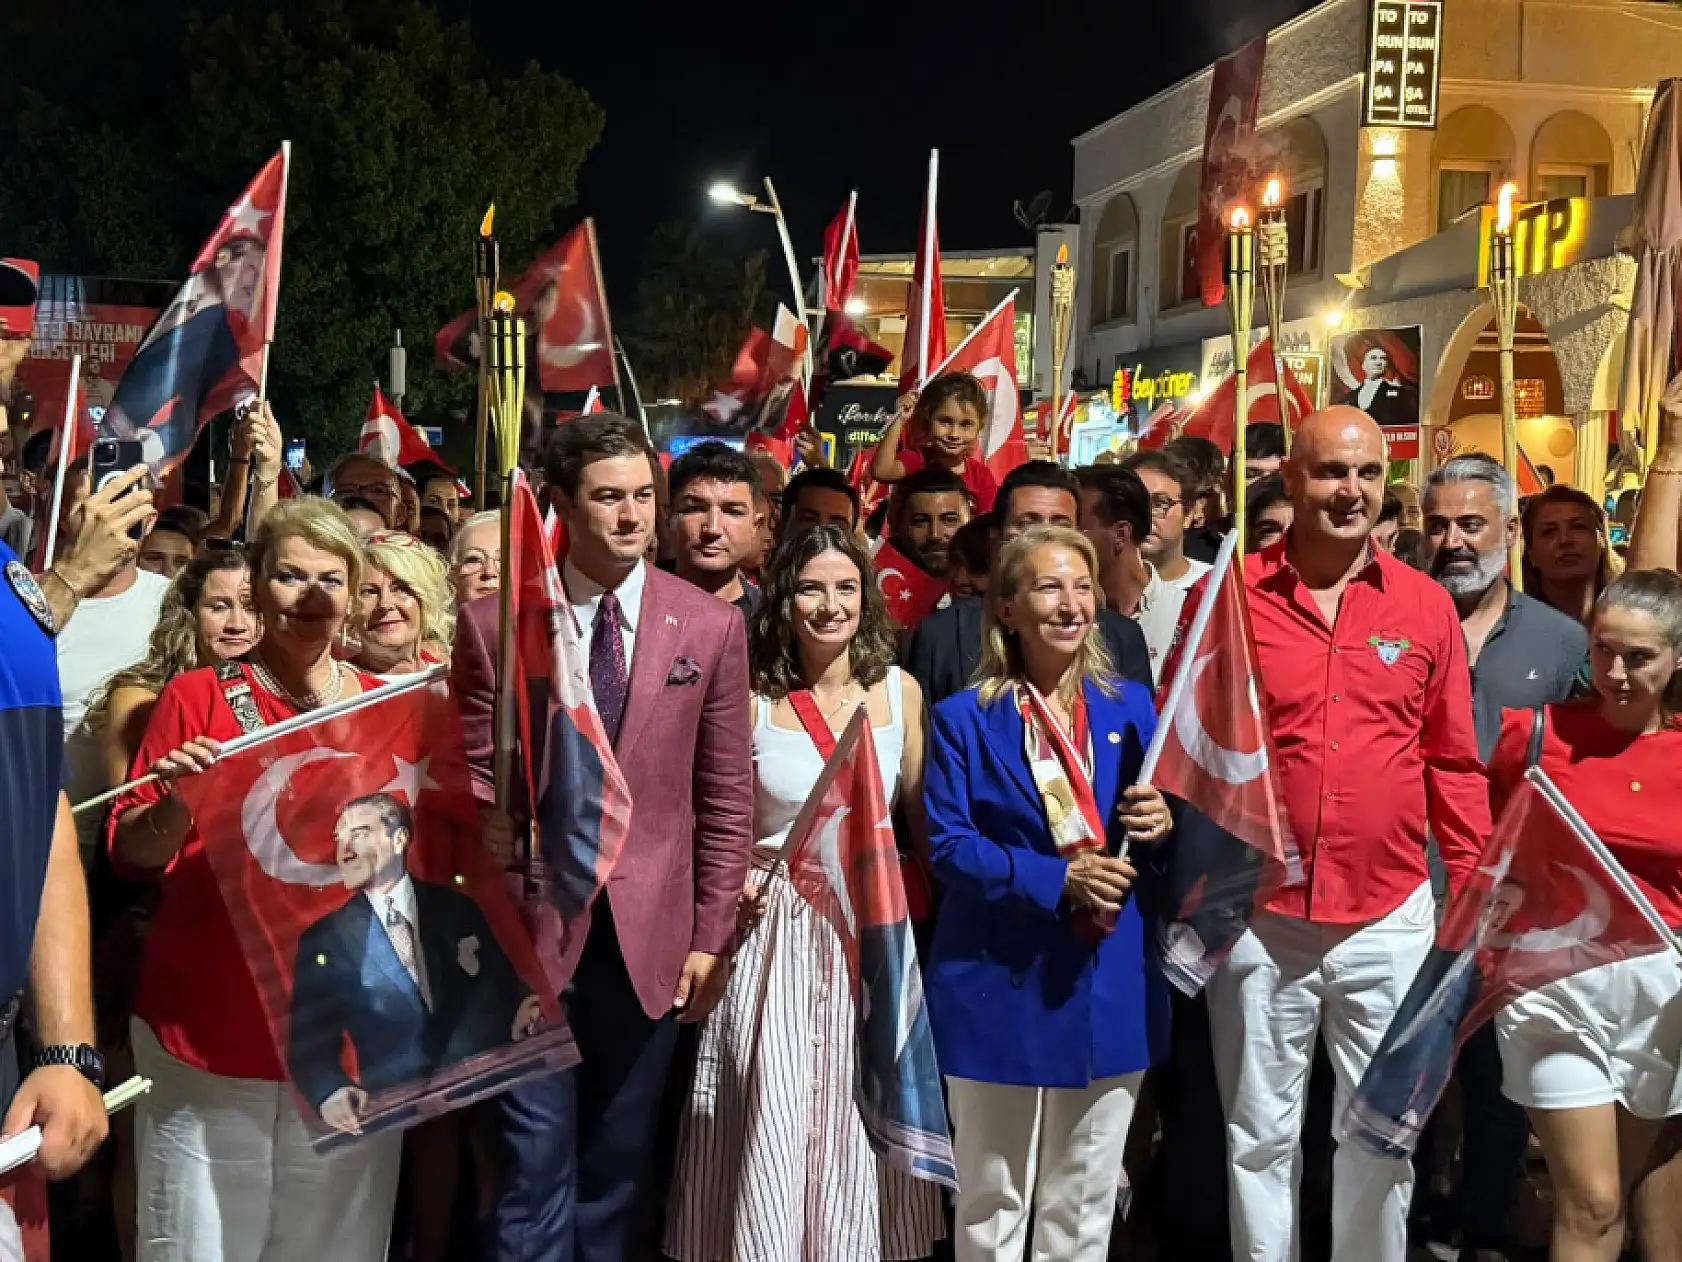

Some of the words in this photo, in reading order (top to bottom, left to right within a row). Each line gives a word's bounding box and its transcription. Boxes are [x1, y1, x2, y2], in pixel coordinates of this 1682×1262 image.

[1378, 9, 1398, 22] TO
[1410, 10, 1429, 24] TO
[1377, 34, 1403, 49] SUN
[1409, 36, 1434, 51] SUN
[1375, 60, 1394, 74] PA
[1407, 61, 1425, 75] PA
